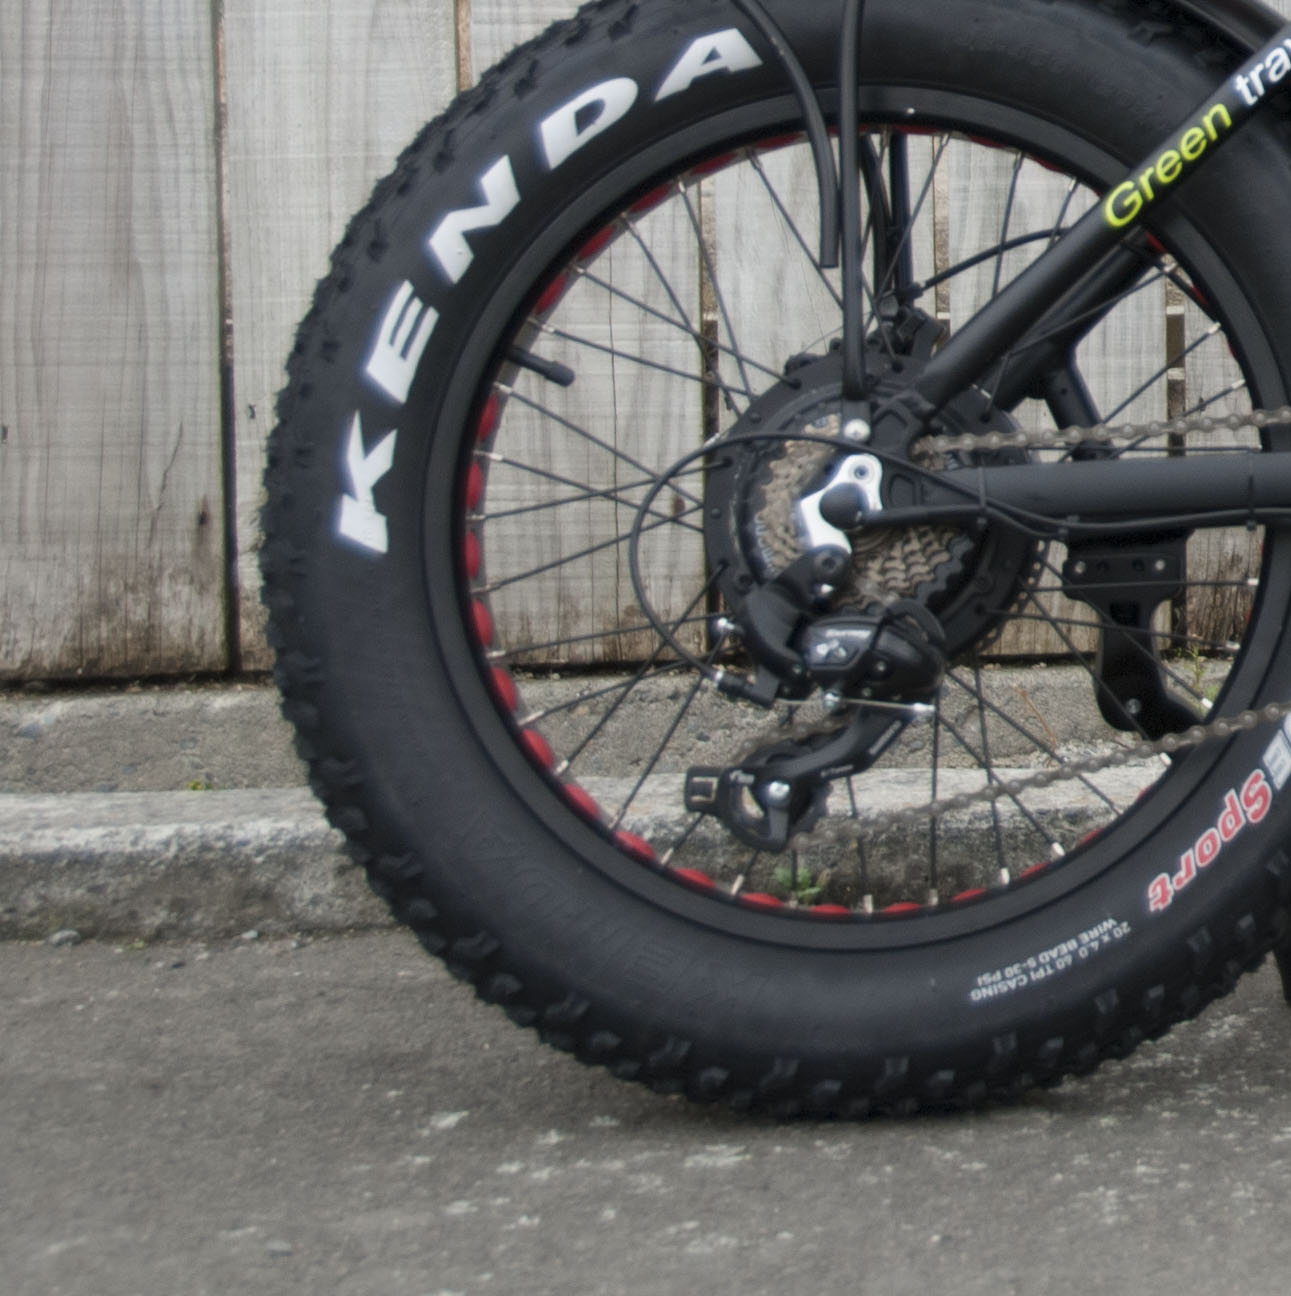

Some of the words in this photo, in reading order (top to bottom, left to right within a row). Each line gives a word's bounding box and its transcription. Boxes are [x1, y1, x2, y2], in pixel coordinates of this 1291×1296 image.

[1105, 103, 1233, 228] Green
[336, 26, 764, 555] KENDA
[1147, 768, 1273, 913] Sport
[1078, 917, 1118, 944] WIRE
[1038, 939, 1079, 963] BEAD
[977, 970, 1003, 987] PSI
[1030, 966, 1055, 981] TPI
[970, 976, 1029, 1002] CASING
